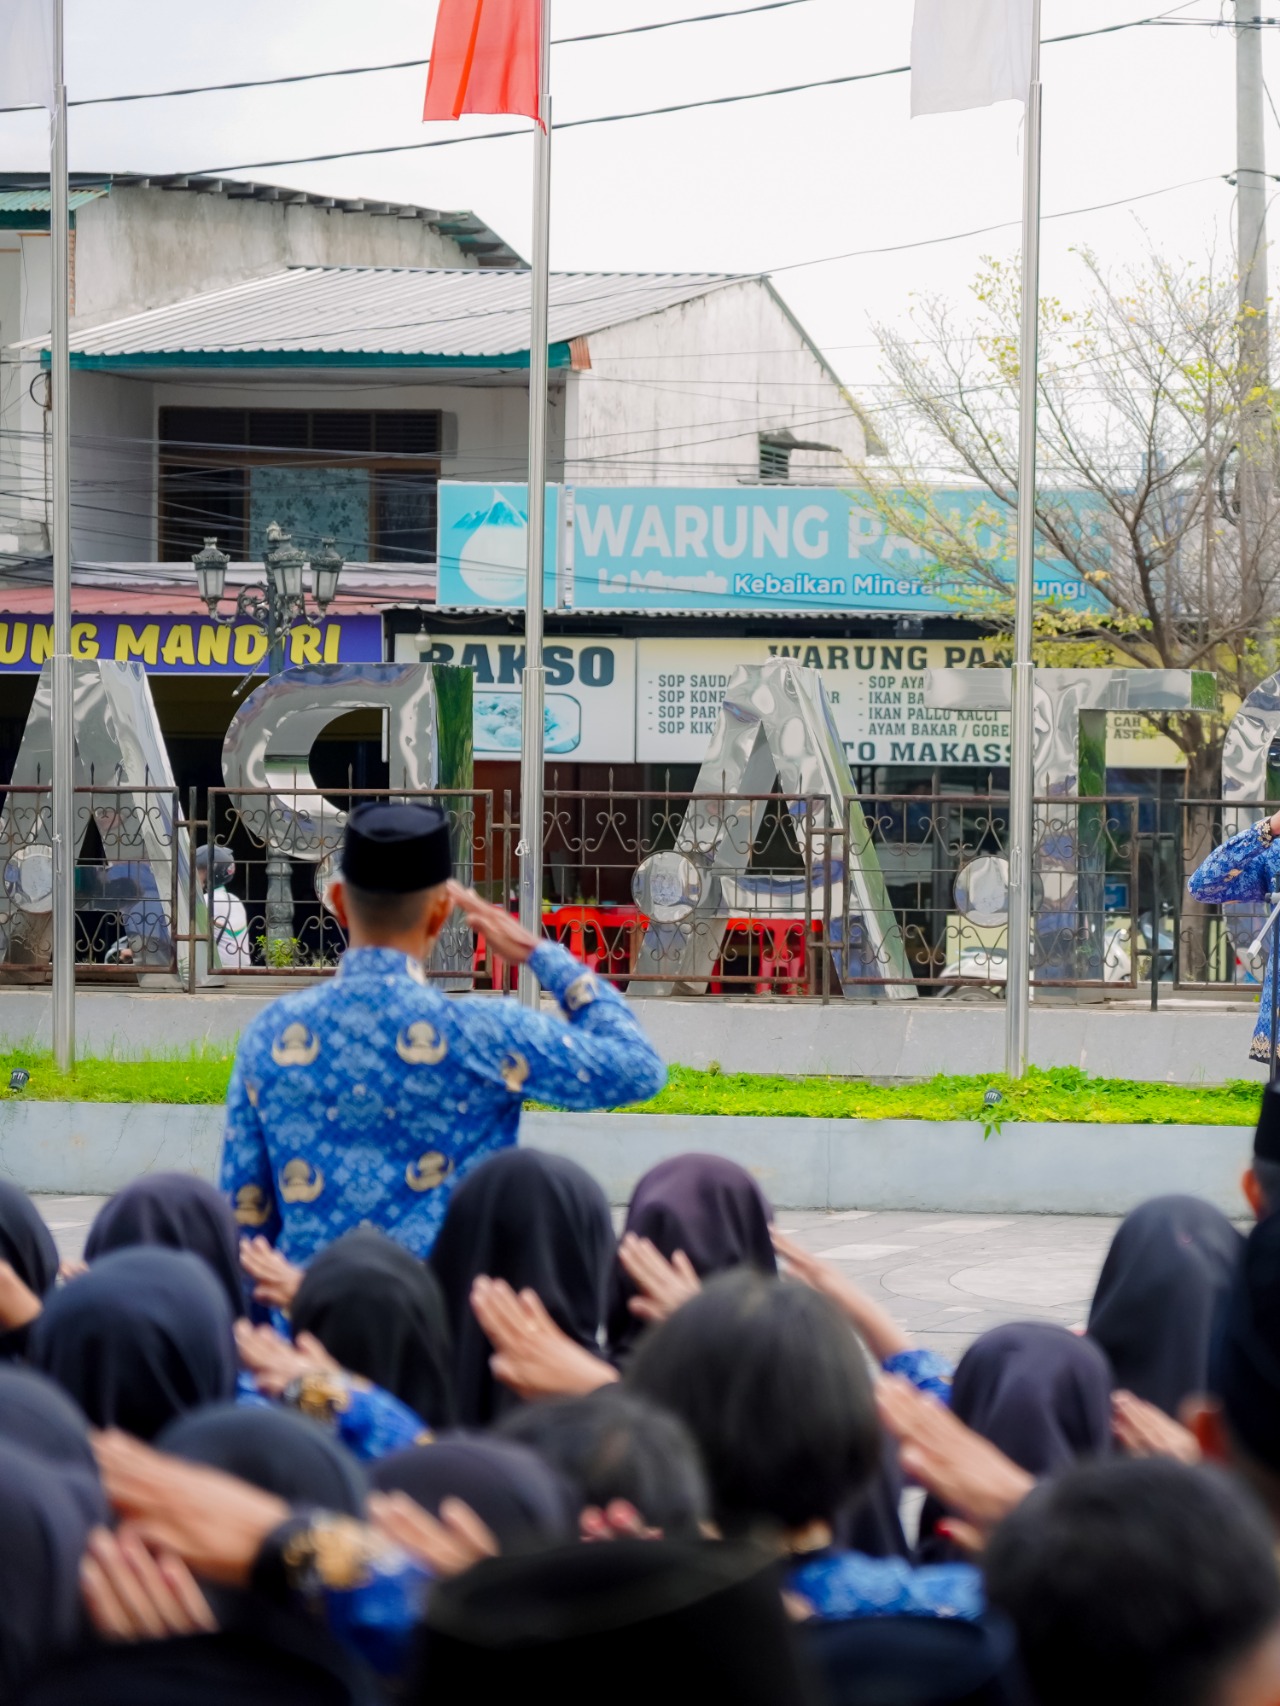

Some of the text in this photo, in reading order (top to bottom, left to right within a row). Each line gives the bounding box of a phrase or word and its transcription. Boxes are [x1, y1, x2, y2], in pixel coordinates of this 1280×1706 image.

[574, 504, 829, 559] WARUNG
[735, 573, 845, 594] Kebaikan
[115, 624, 341, 666] MANDRI
[768, 646, 928, 670] WARUNG
[658, 675, 685, 688] SOP
[869, 676, 896, 689] SOP
[658, 691, 685, 703] SOP
[869, 692, 901, 704] IKAN
[658, 706, 685, 718] SOP
[869, 708, 901, 720] IKAN
[658, 722, 685, 734] SOP
[868, 723, 905, 736] AYAM
[911, 724, 957, 736] BAKAR
[973, 725, 1009, 737] GORE
